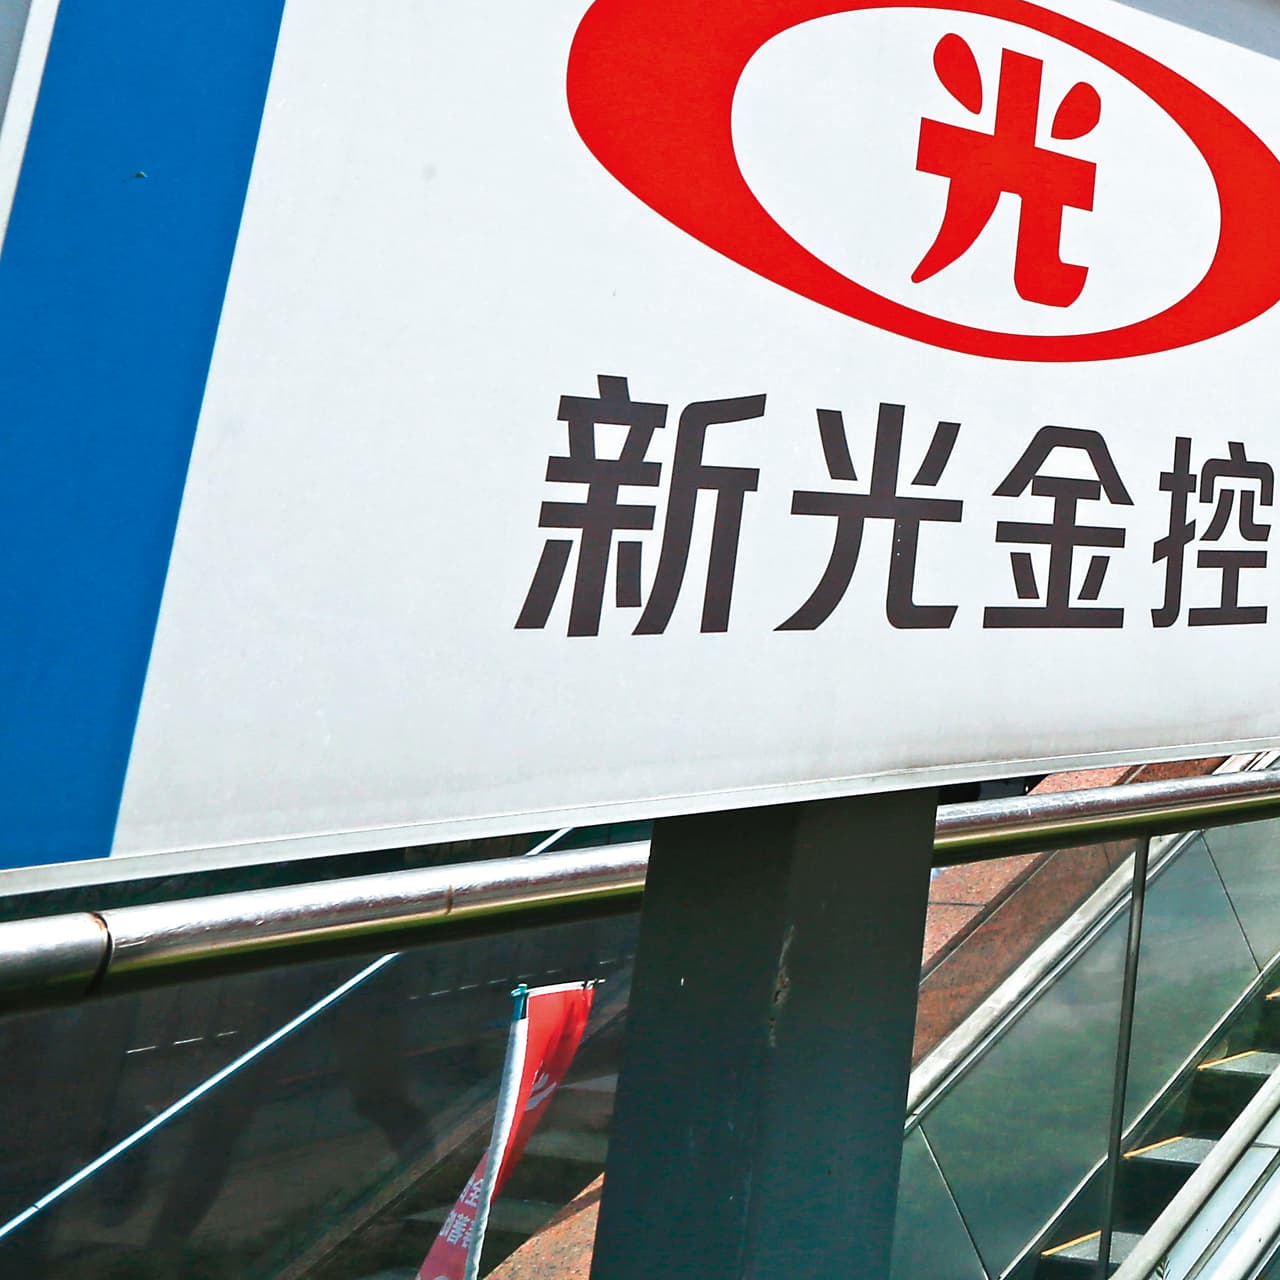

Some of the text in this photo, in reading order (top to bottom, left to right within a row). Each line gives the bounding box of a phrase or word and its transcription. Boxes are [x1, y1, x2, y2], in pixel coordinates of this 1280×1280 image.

[911, 31, 1104, 309] 光
[514, 374, 1276, 638] 新光金控
